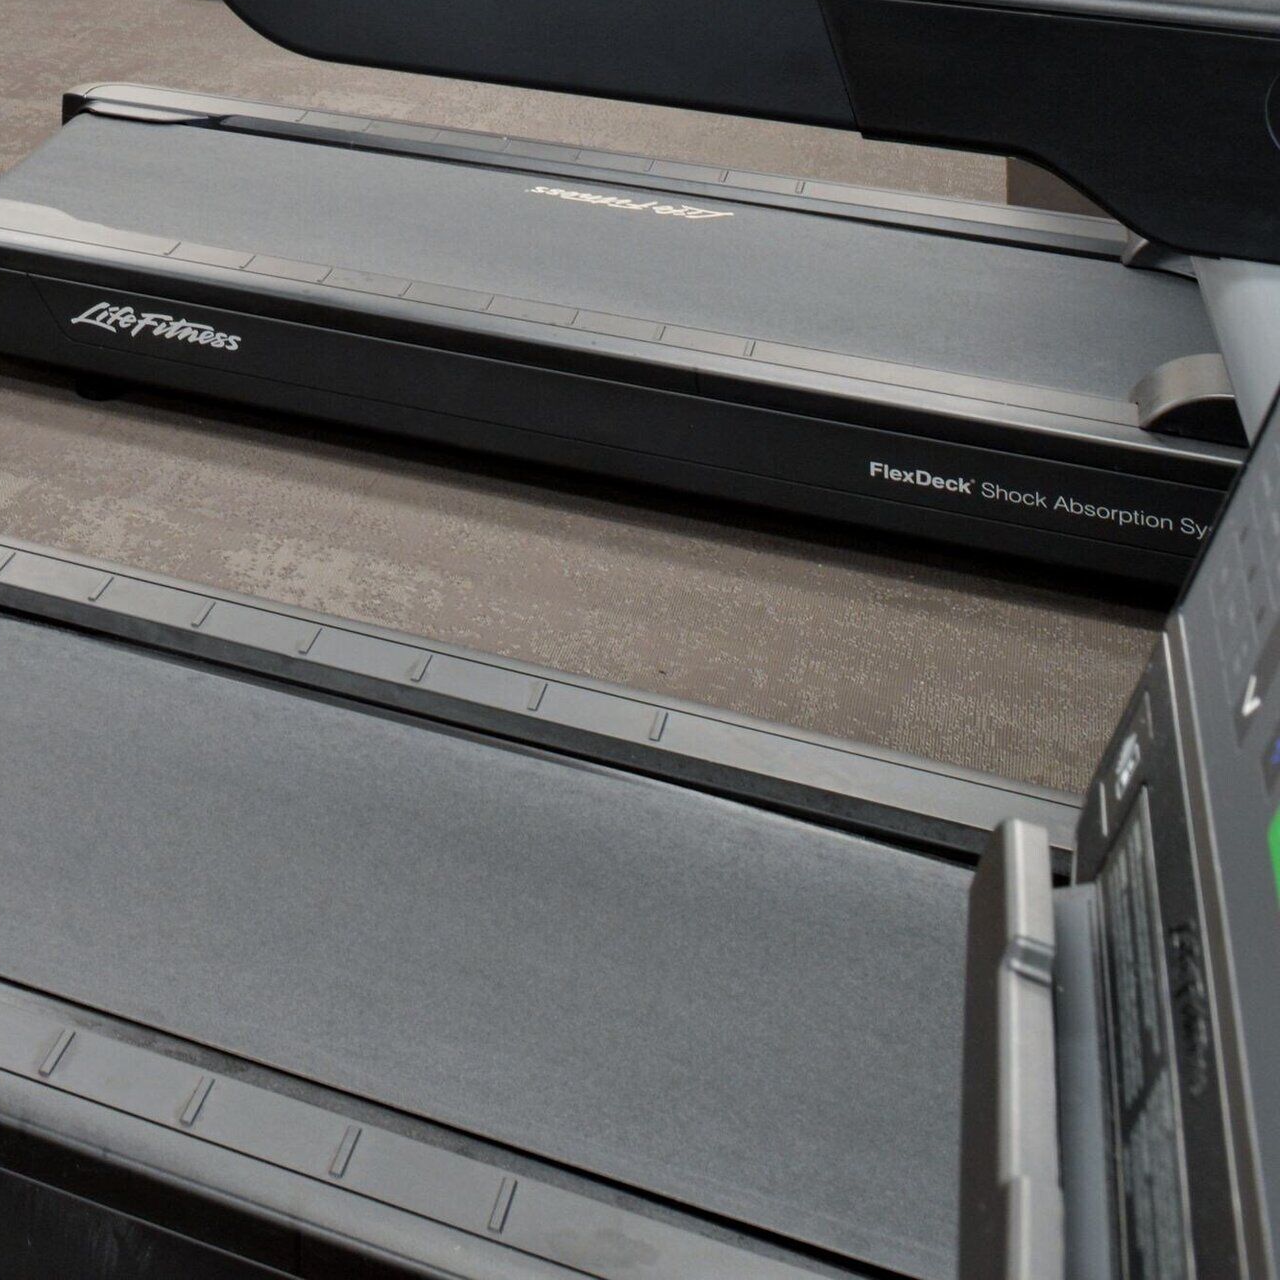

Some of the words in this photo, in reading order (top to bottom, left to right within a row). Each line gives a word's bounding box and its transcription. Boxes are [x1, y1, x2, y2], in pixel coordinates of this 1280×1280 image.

[981, 481, 1048, 509] Shock
[1053, 494, 1174, 532] Absorption
[1180, 517, 1213, 540] Sy
